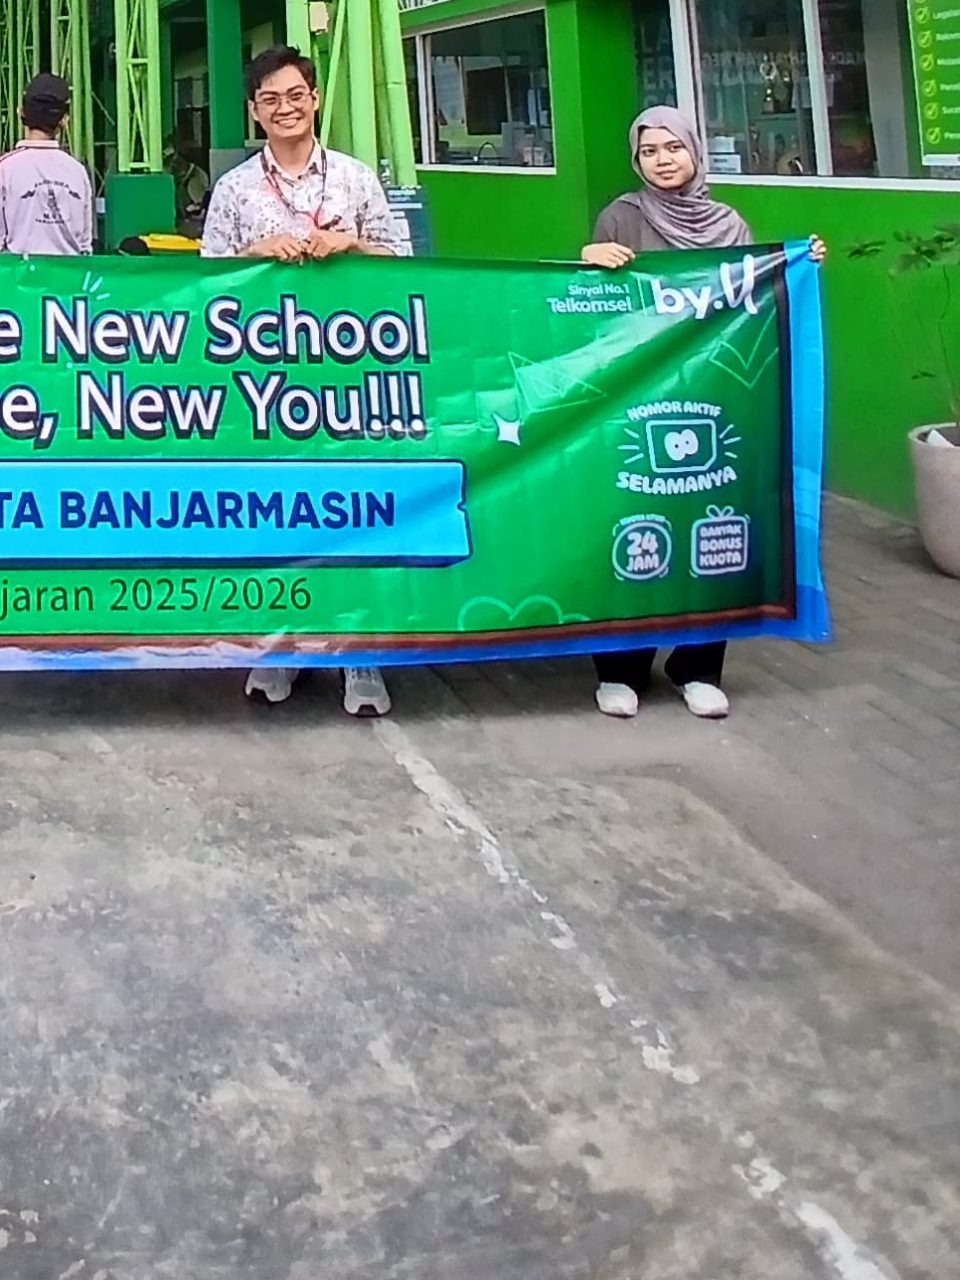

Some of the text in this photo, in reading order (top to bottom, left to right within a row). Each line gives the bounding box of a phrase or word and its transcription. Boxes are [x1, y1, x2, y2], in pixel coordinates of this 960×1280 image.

[568, 283, 630, 297] Sinyal No.1
[547, 297, 632, 314] Telkomsel
[41, 293, 189, 363] New
[205, 294, 430, 363] School
[75, 371, 225, 439] New
[235, 372, 427, 439] You!!!
[627, 401, 722, 421] NOMOR AKTIF
[616, 466, 737, 494] SELAMANYA
[60, 491, 395, 530] BANJARMASIN
[626, 530, 658, 555] 24
[700, 537, 742, 552] BONUS
[626, 554, 659, 571] JAM
[700, 552, 742, 567] KUOTA
[108, 577, 312, 615] 2025/2026
